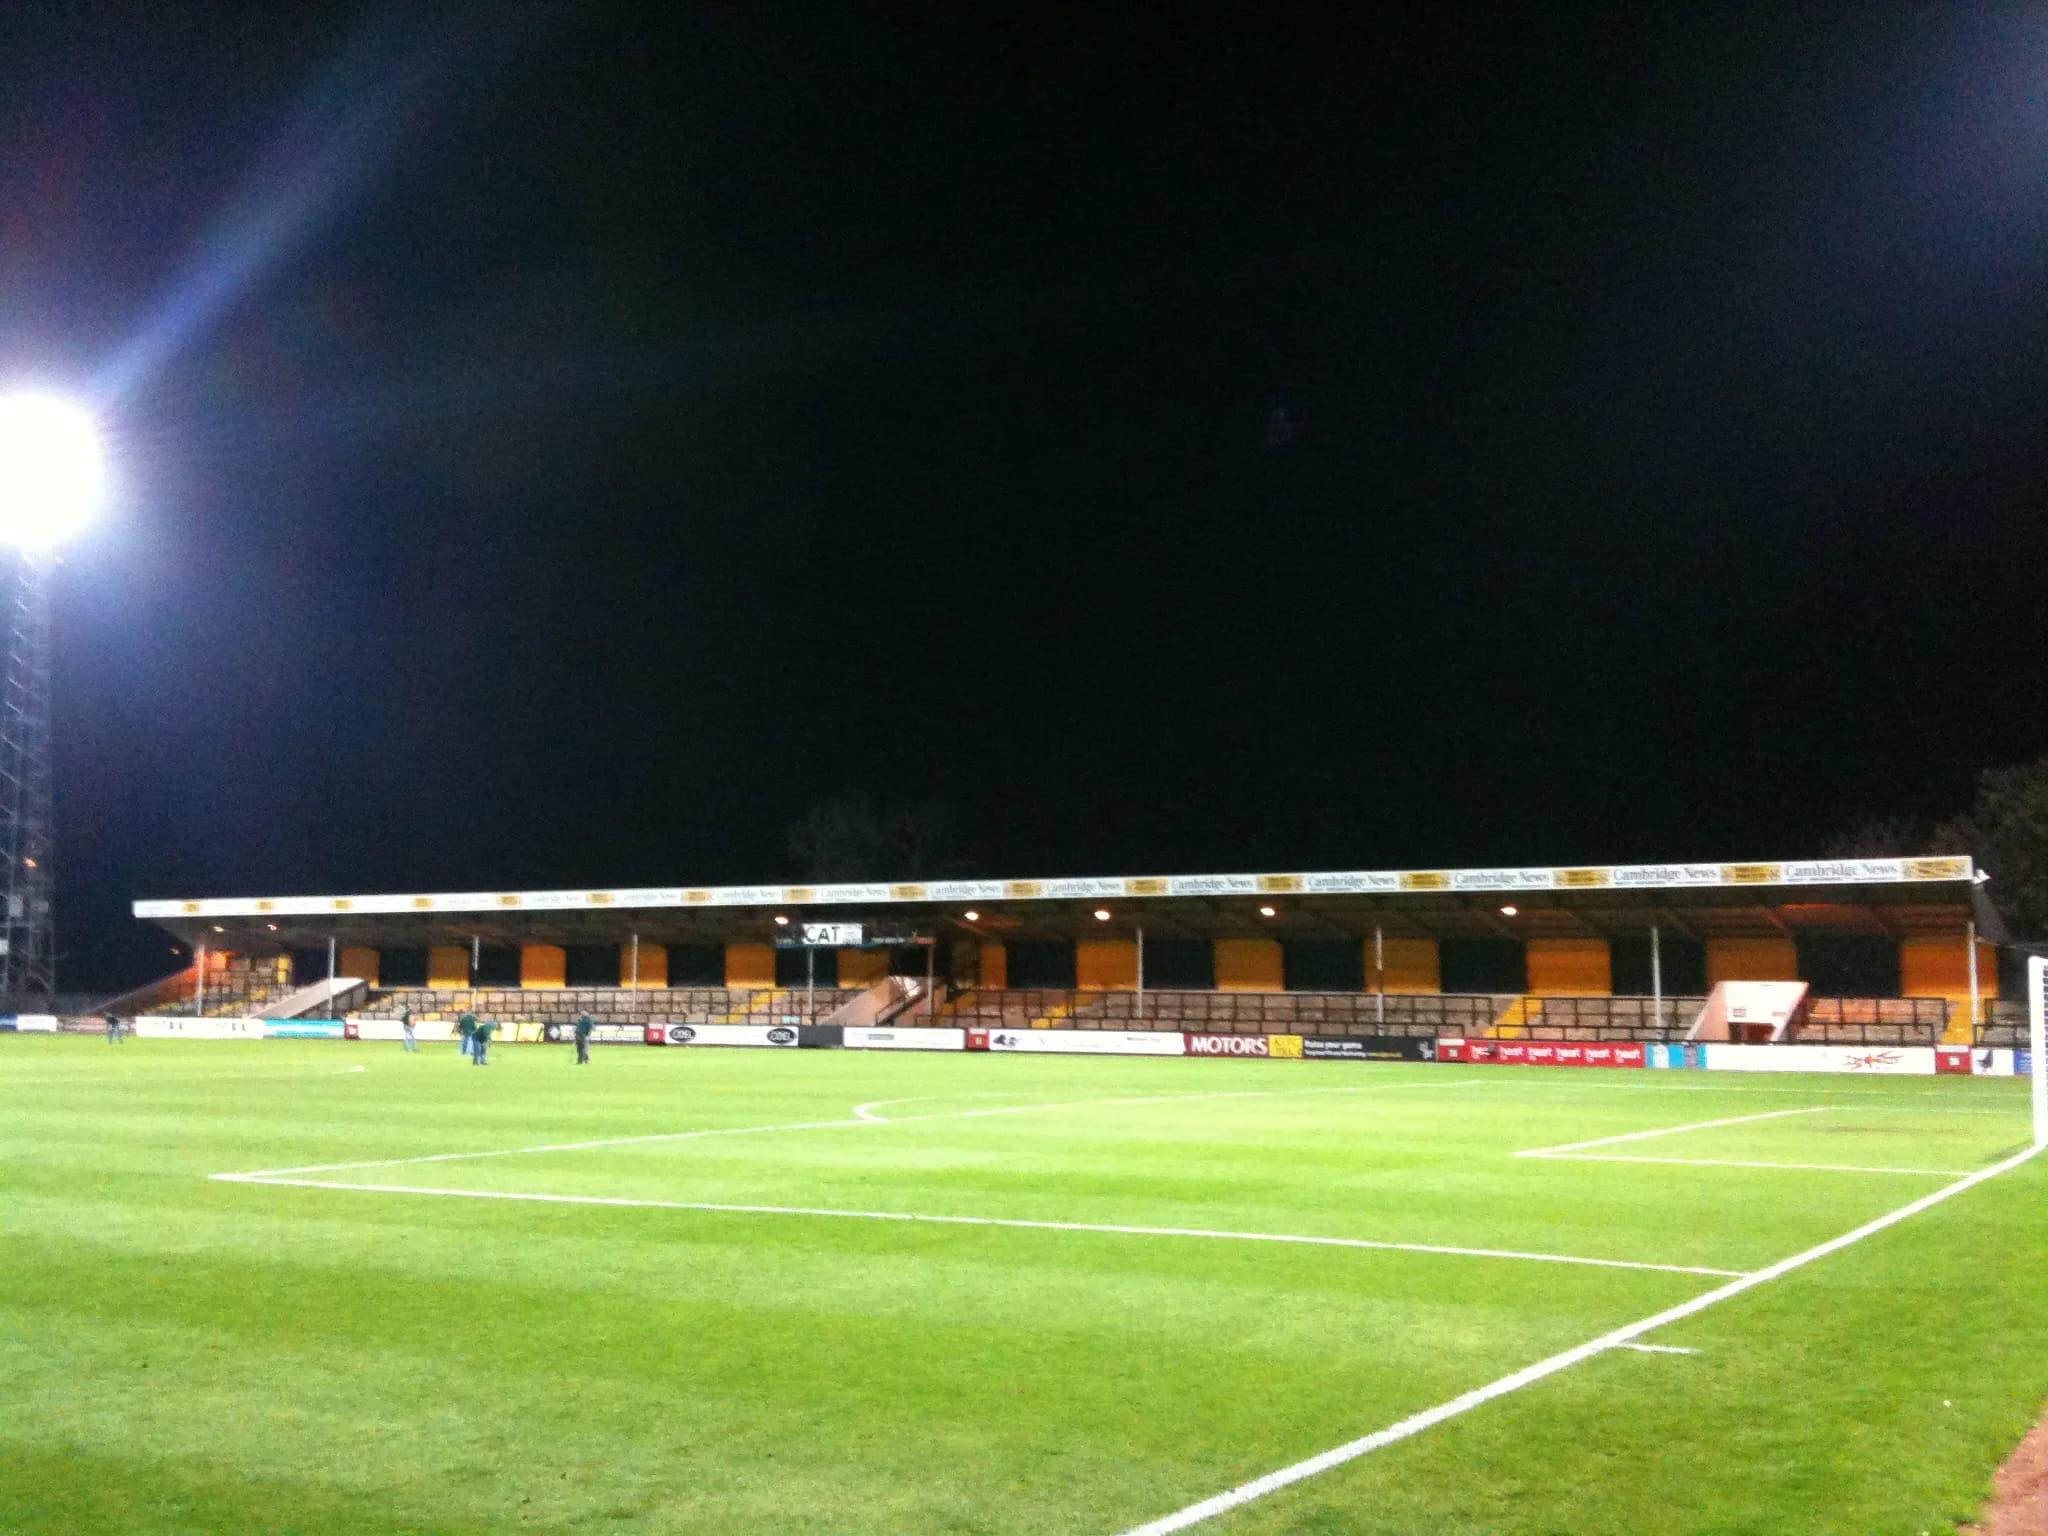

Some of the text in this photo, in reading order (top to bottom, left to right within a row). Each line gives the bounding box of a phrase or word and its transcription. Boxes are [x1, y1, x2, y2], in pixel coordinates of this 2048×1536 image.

[1613, 867, 1717, 881] Cambridge News
[1785, 863, 1898, 877] Cambridge News
[1171, 878, 1225, 891] Cambridge
[1226, 877, 1254, 888] News
[1307, 874, 1396, 888] Cambridge News
[1454, 871, 1517, 886] Cambridge
[1519, 871, 1550, 882] News
[1191, 1036, 1267, 1054] MOTORS
